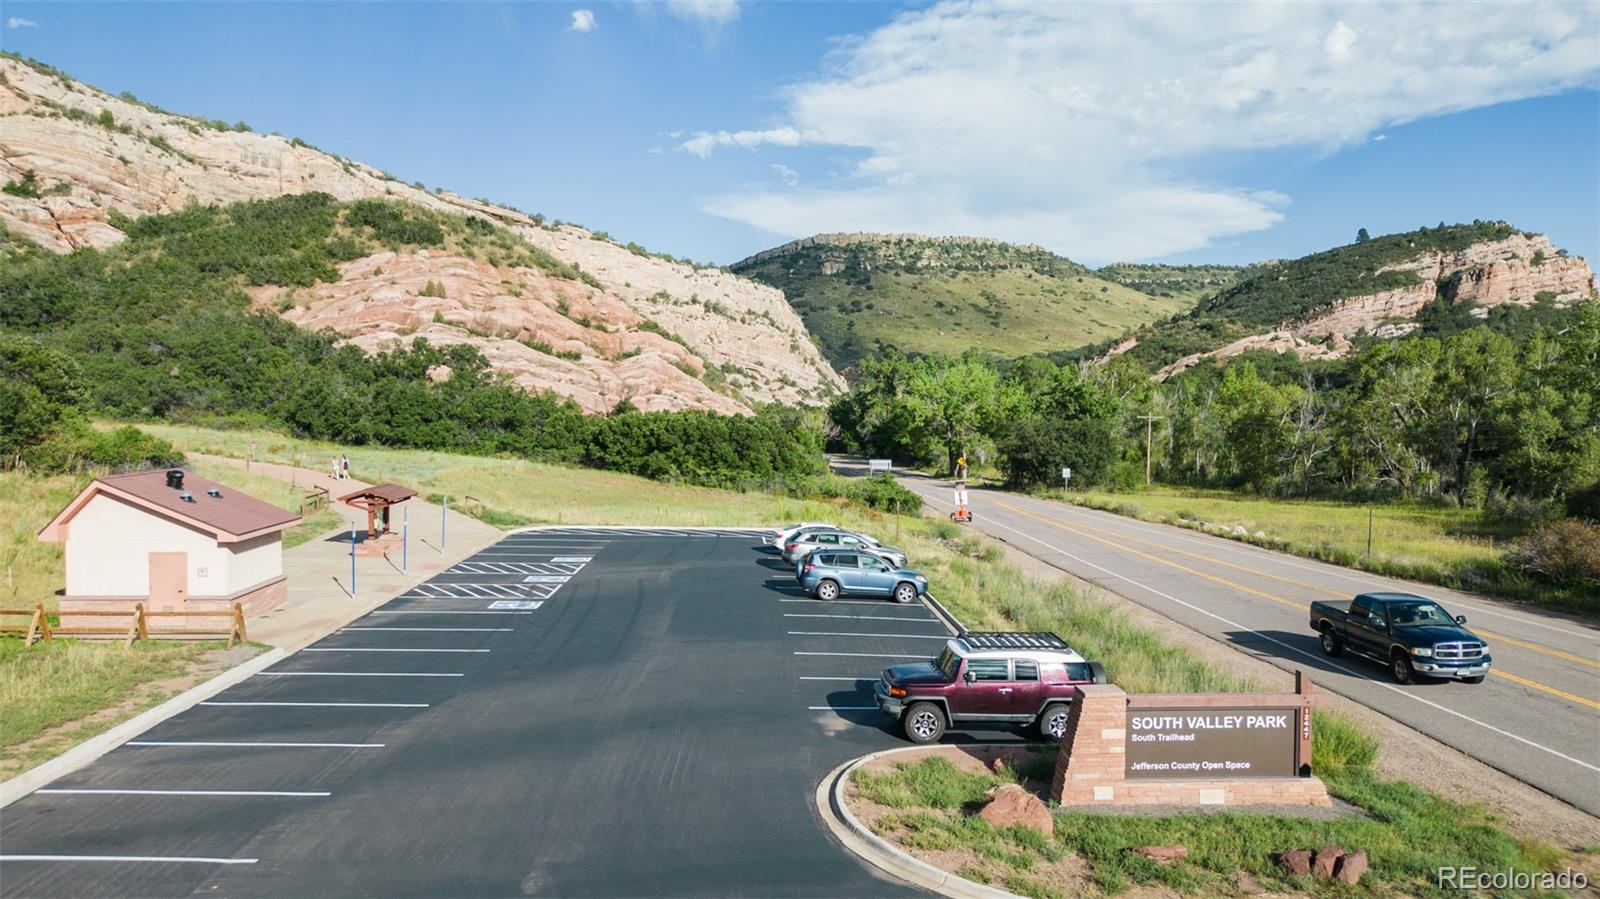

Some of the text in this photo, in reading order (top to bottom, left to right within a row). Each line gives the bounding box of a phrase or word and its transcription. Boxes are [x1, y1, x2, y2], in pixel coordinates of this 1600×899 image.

[1131, 715, 1287, 730] SOUTH VALLEY PARK
[1131, 732, 1195, 742] South Trailhead
[1131, 760, 1251, 772] Jefferson County Open Space
